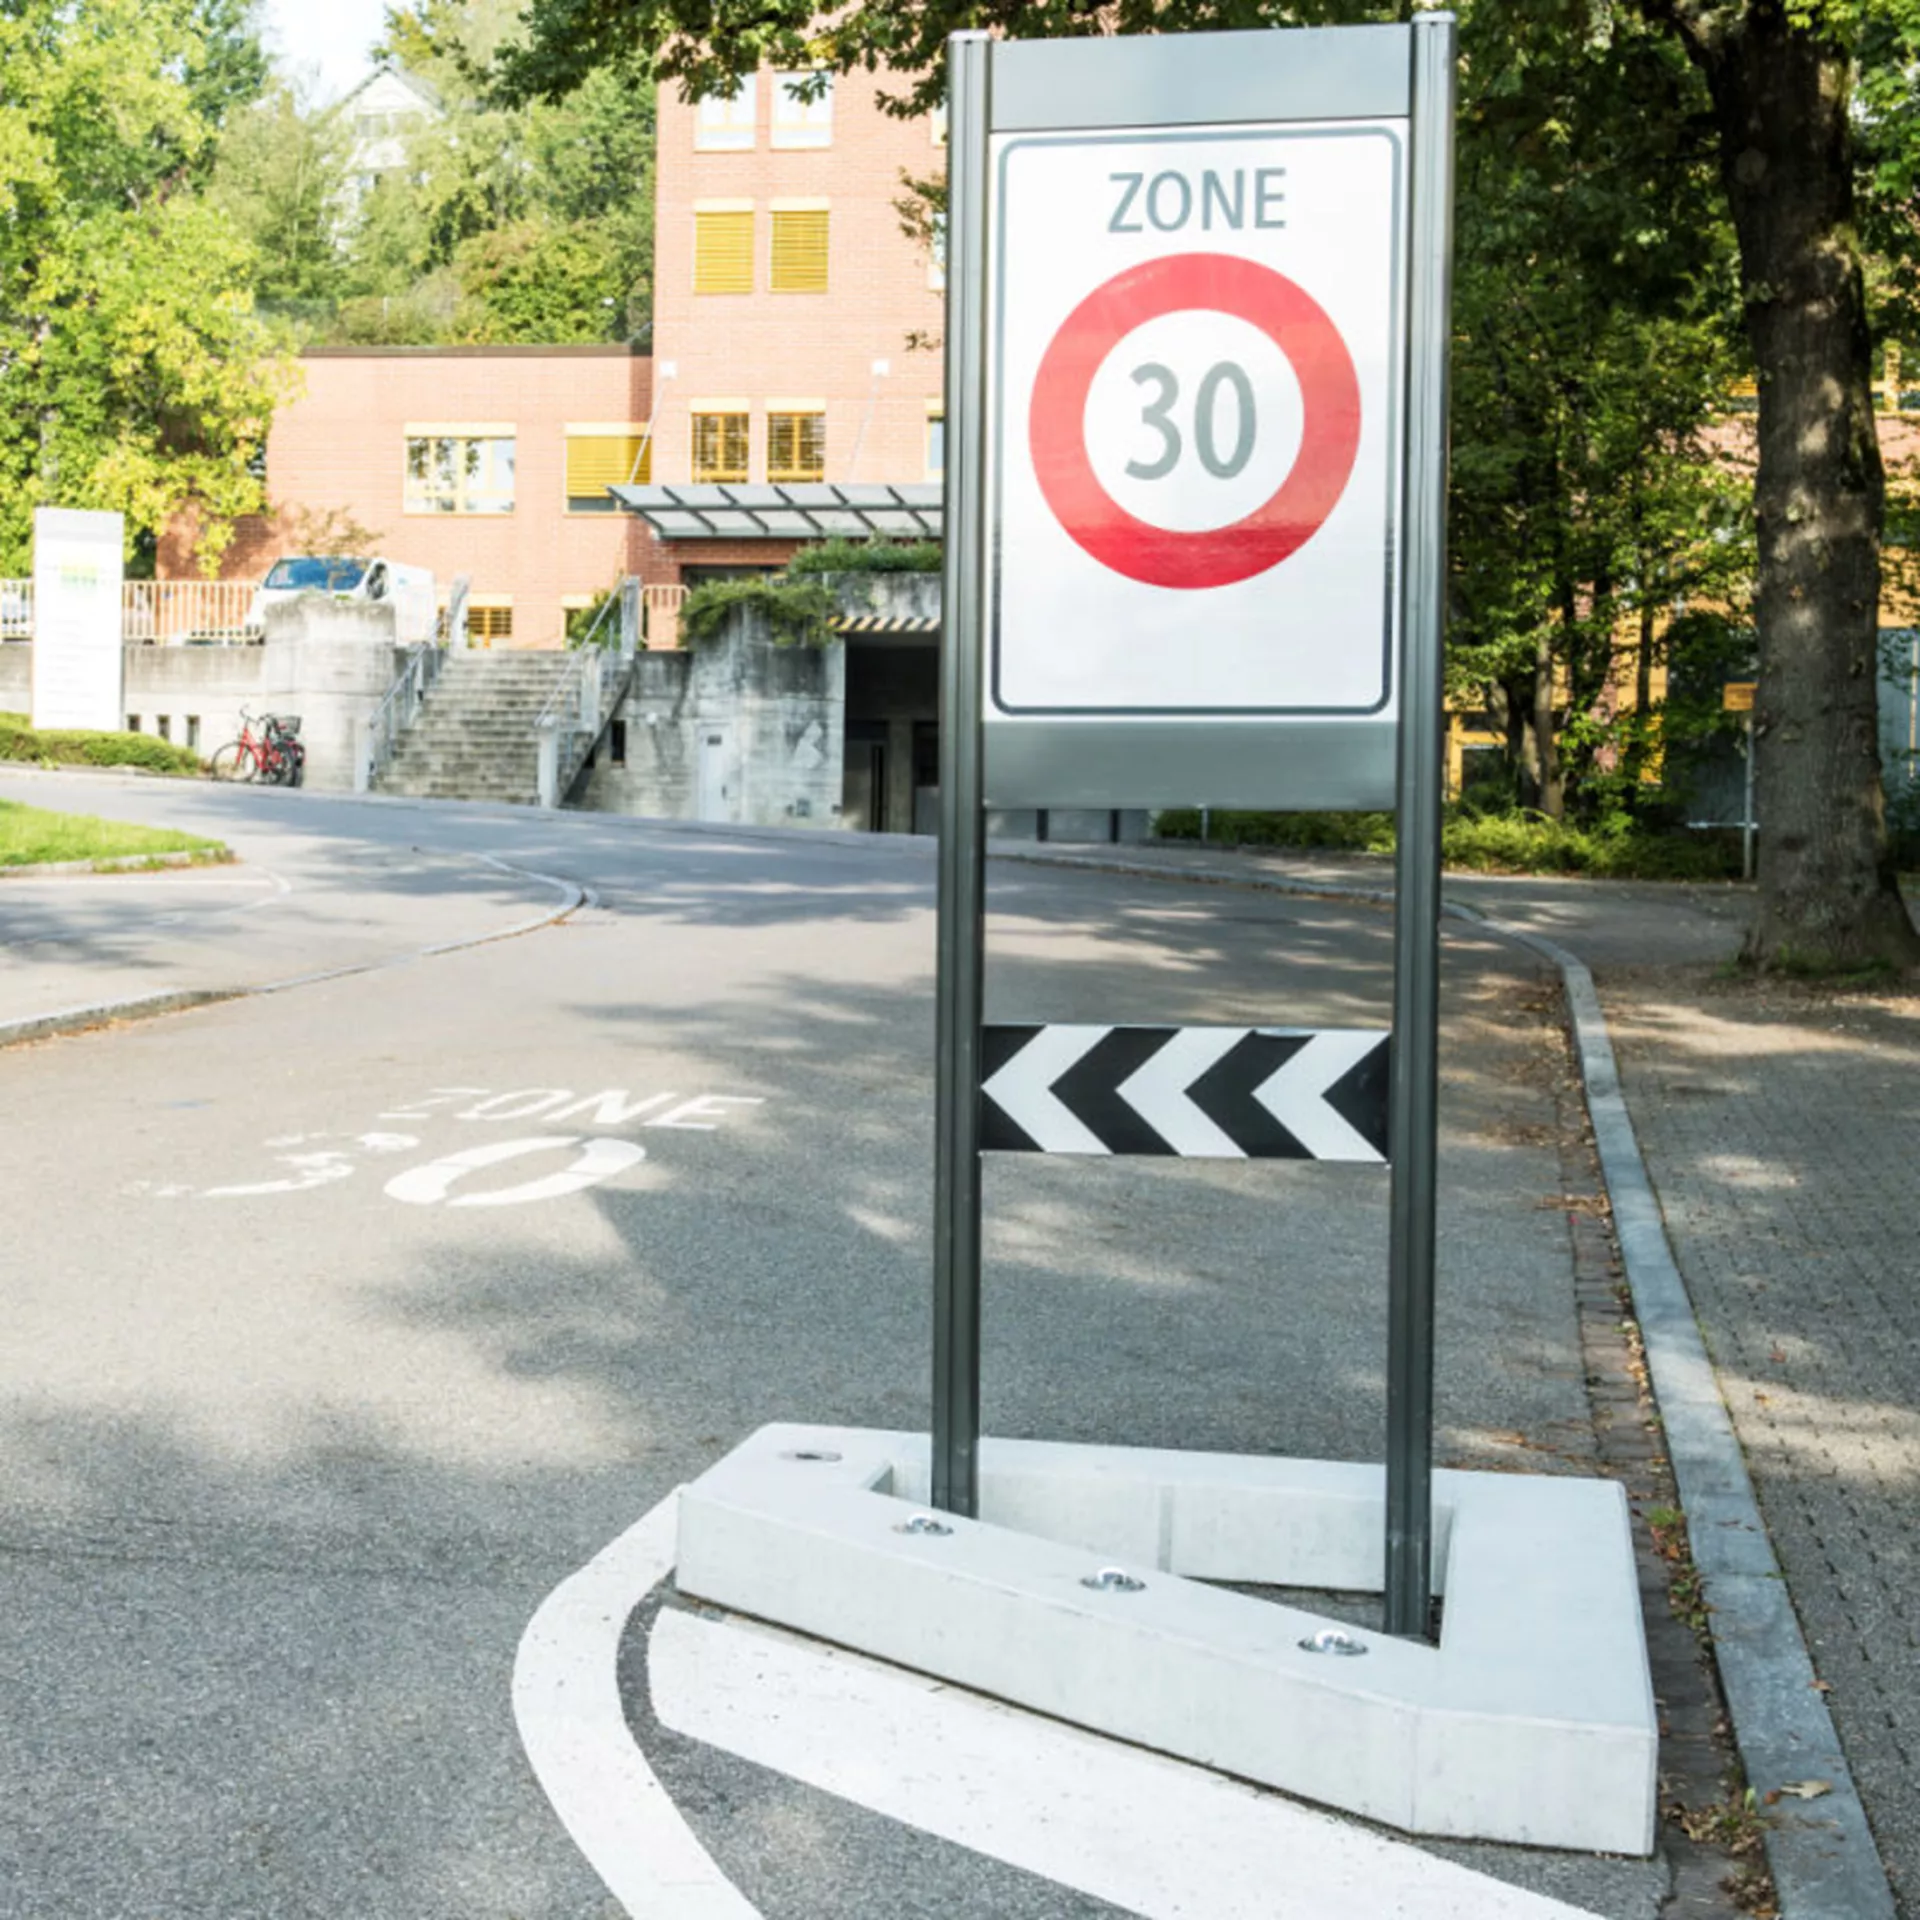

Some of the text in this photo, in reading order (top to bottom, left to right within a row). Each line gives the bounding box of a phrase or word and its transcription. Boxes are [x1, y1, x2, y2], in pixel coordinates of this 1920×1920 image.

[1108, 168, 1287, 233] ZONE
[1124, 361, 1258, 481] 30
[378, 1087, 766, 1131] ZONE
[134, 1131, 646, 1207] 30
